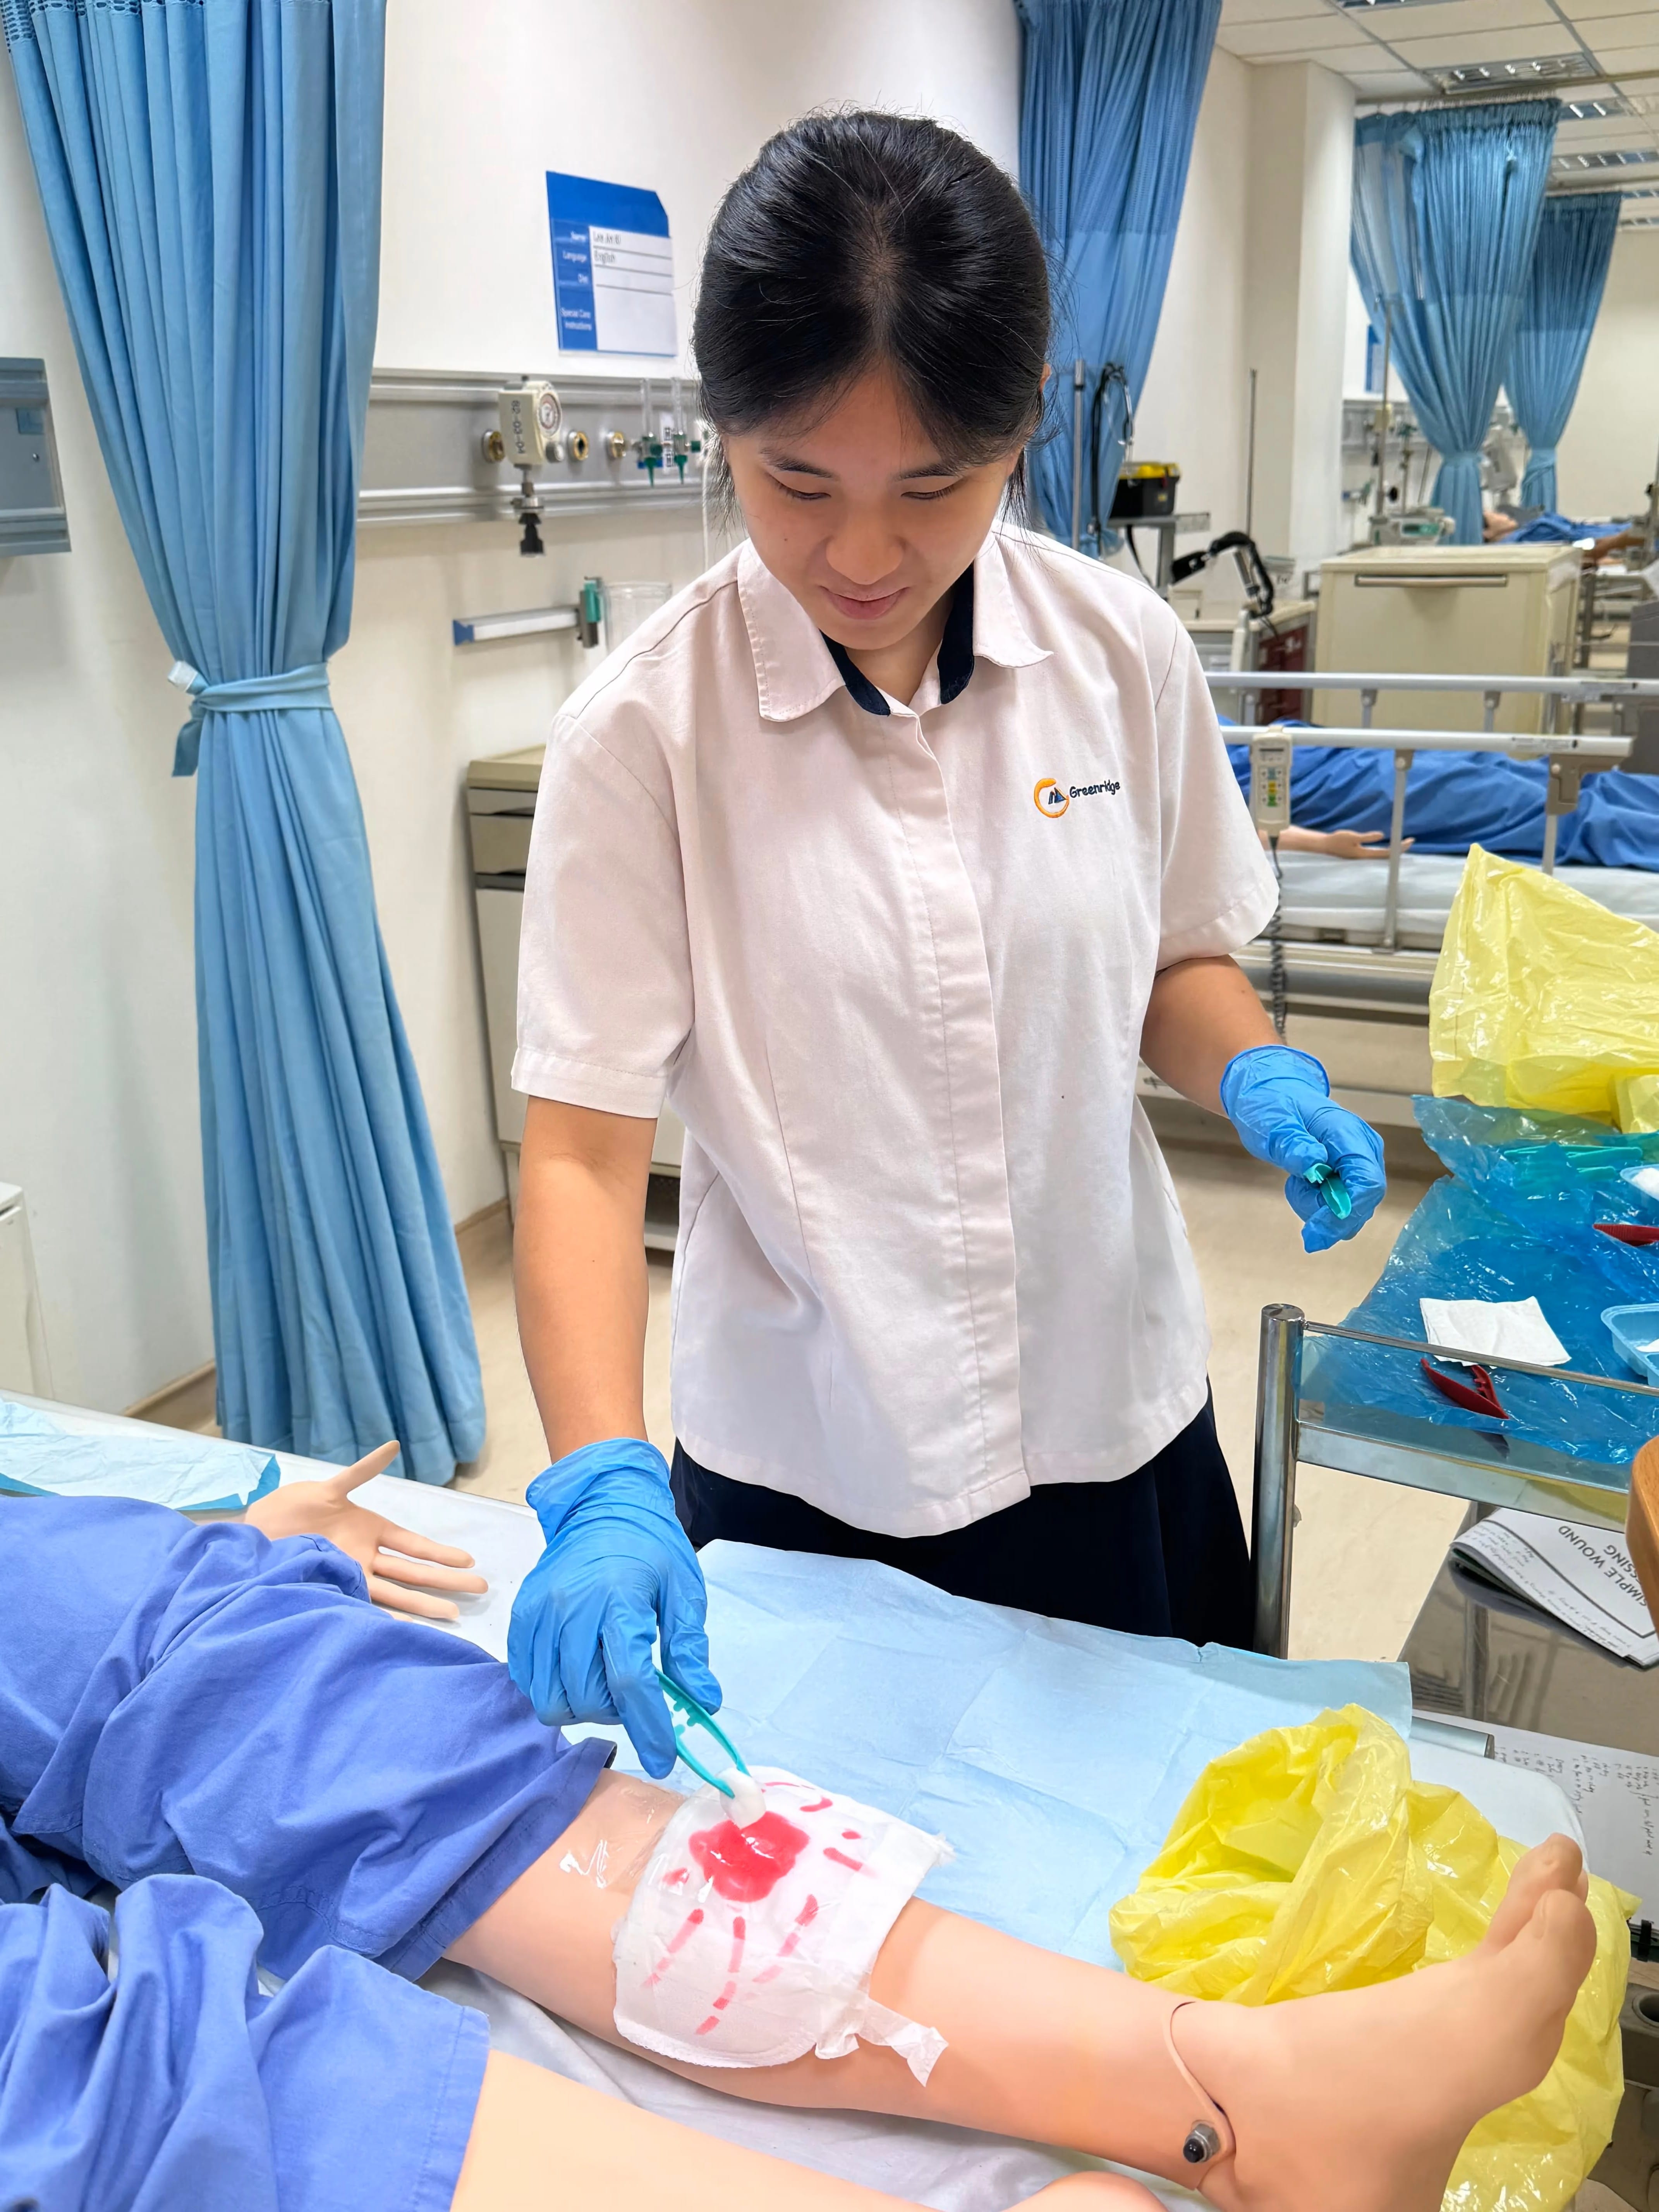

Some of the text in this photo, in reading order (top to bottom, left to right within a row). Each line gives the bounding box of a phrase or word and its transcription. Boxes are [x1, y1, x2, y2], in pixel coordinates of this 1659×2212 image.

[594, 250, 616, 264] English
[1070, 779, 1120, 798] Greenridge
[1558, 1526, 1606, 1568] WOUND
[1603, 1544, 1640, 1584] SSING
[1604, 1566, 1647, 1606] SIMPLE
